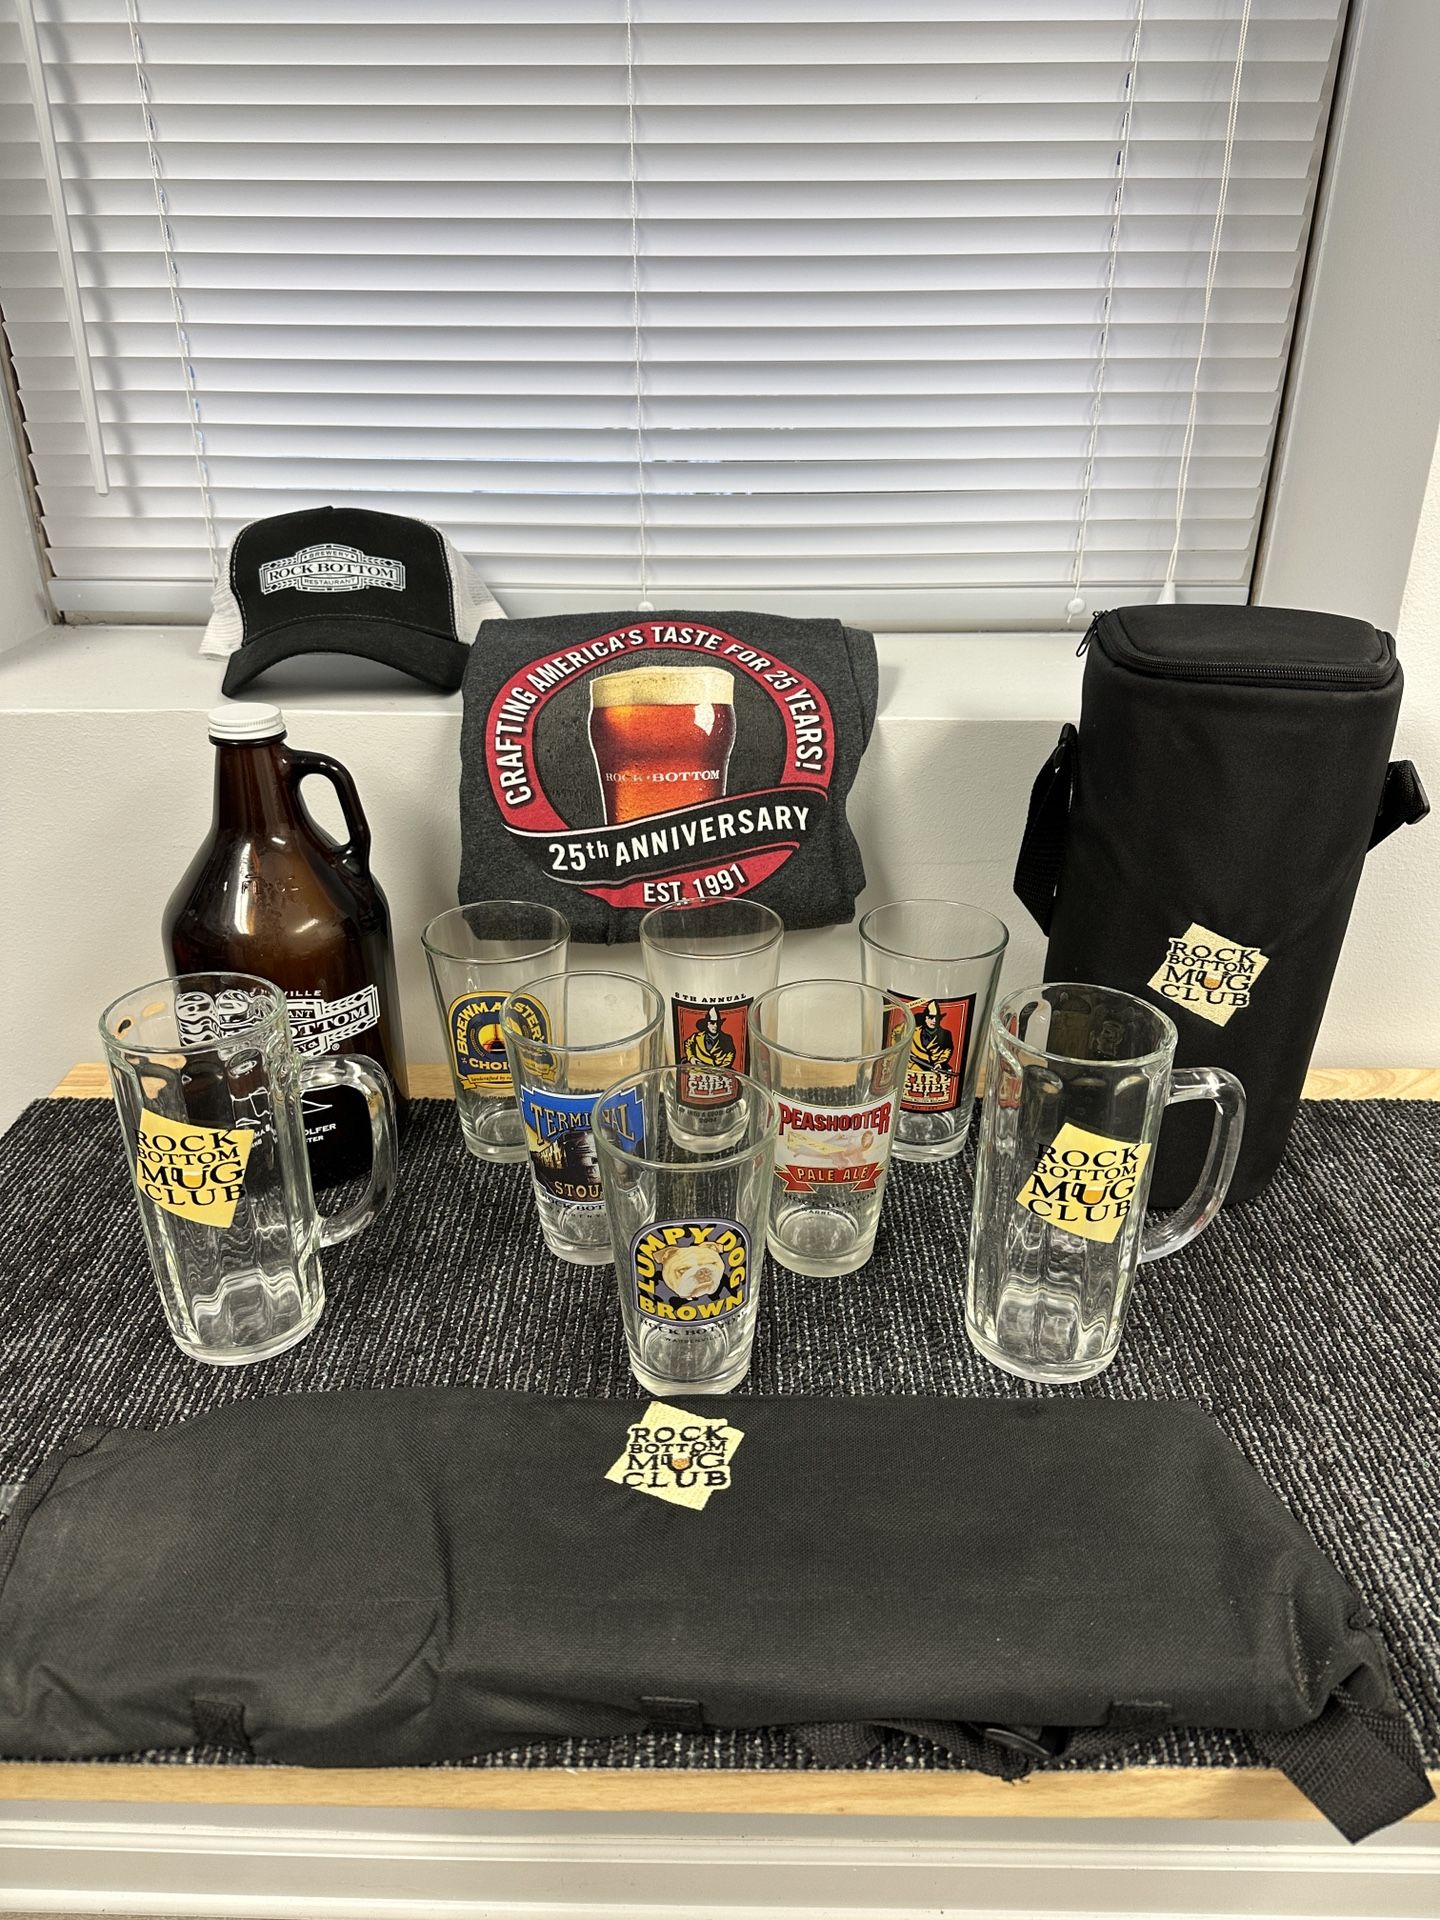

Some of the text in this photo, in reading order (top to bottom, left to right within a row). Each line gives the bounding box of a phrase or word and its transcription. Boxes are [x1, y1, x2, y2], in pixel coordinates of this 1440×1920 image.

[309, 549, 350, 558] BREWERY
[269, 563, 394, 581] ROCK BOTTOM
[495, 625, 824, 806] CRAFTING AMERICA'S TASTE FOR 25 YEARS!
[606, 769, 720, 783] ROCK BOTTOM
[549, 805, 810, 872] 25th ANNIVERSARY
[693, 863, 747, 903] 1991
[1170, 940, 1258, 963] ROCK
[1168, 953, 1255, 973] BOTTOM
[1163, 965, 1252, 991] MUG
[702, 994, 747, 1003] ANNUAL
[1161, 984, 1250, 1007] CLUB
[468, 1057, 511, 1071] CHOI
[688, 1081, 733, 1092] CHIEF
[905, 1073, 951, 1085] FIRE
[778, 1101, 892, 1135] PEASHOOTER
[135, 1128, 240, 1152] ROCK
[137, 1147, 241, 1166] BOTTOM
[1036, 1142, 1141, 1167] ROCK
[140, 1160, 245, 1190] MUG
[797, 1166, 869, 1181] PALE ALE
[1034, 1161, 1138, 1181] BOTTOM
[144, 1184, 245, 1206] CLUB
[554, 1181, 603, 1198] STOU
[1031, 1174, 1137, 1206] MUG
[1028, 1198, 1131, 1222] CLUB
[638, 1227, 746, 1294] LUMPY DOG
[639, 1290, 744, 1321] BROWN
[631, 1426, 729, 1443] ROCK
[630, 1440, 727, 1453] BOTTOM
[627, 1452, 725, 1473] MUG
[623, 1470, 728, 1488] CLUB
